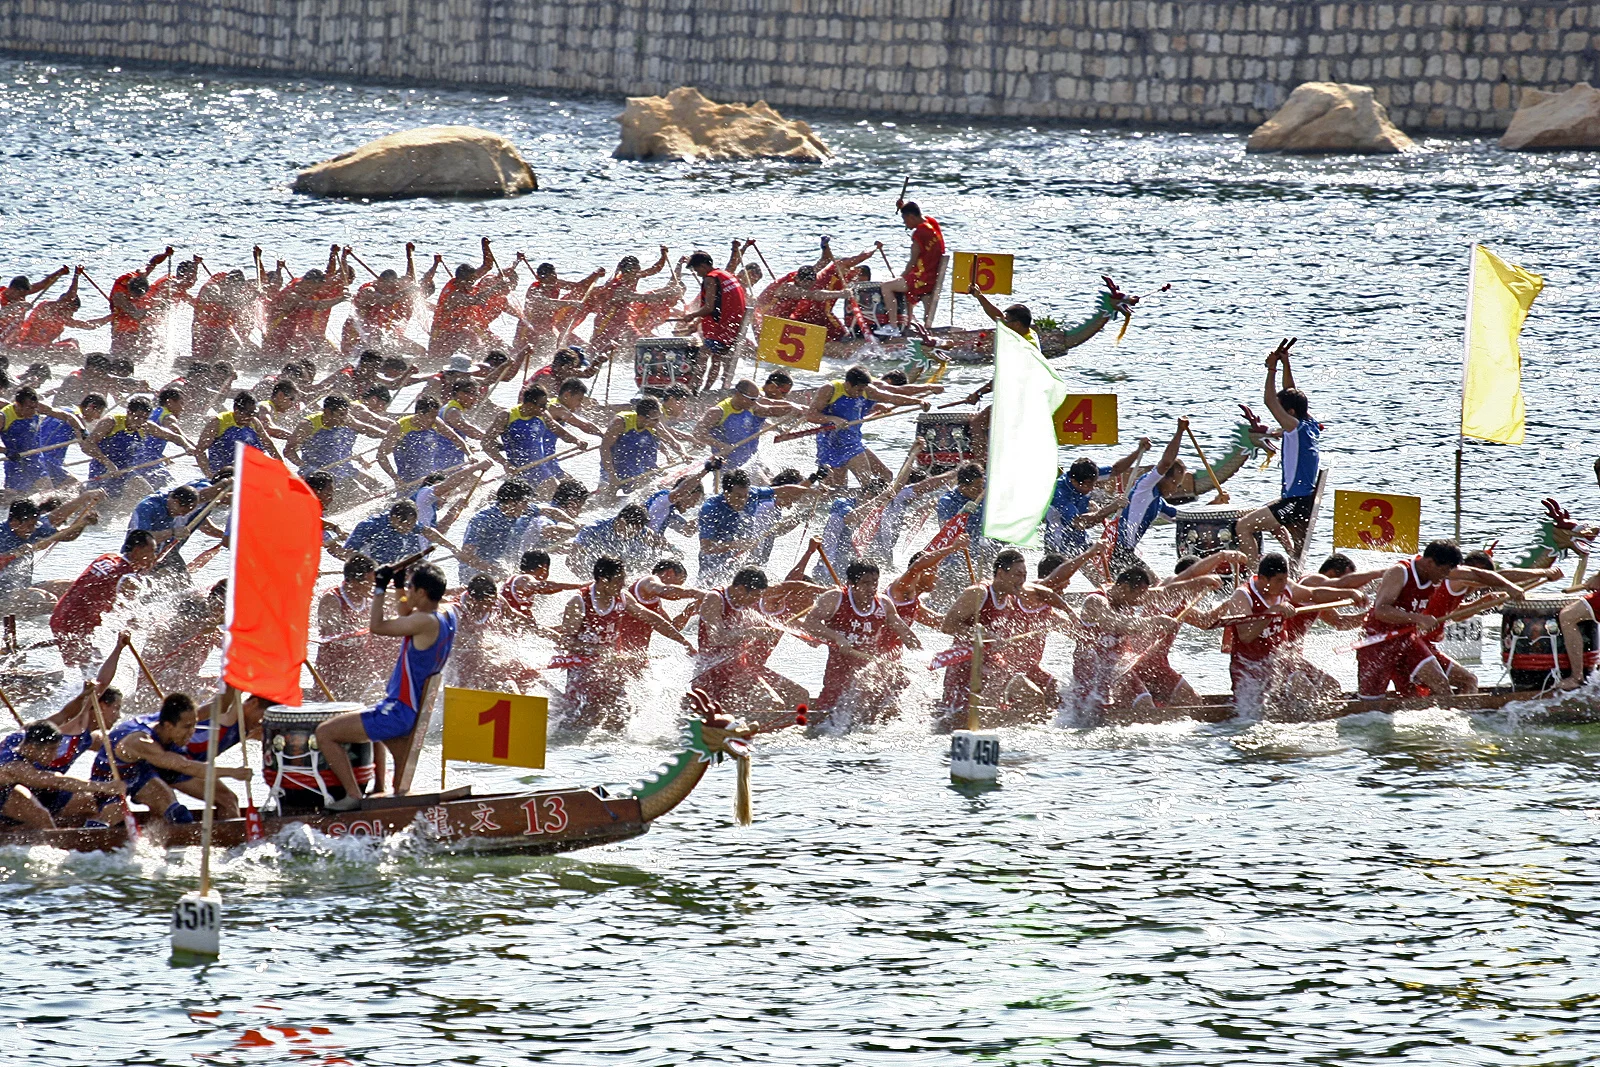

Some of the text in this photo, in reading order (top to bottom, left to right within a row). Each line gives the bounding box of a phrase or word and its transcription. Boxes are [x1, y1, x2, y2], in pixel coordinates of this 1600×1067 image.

[970, 257, 996, 292] 6
[777, 324, 806, 363] 5
[1063, 398, 1097, 441] 4
[1358, 498, 1395, 544] 3
[478, 699, 511, 759] 1
[973, 740, 1000, 766] 450
[520, 796, 569, 836] 13
